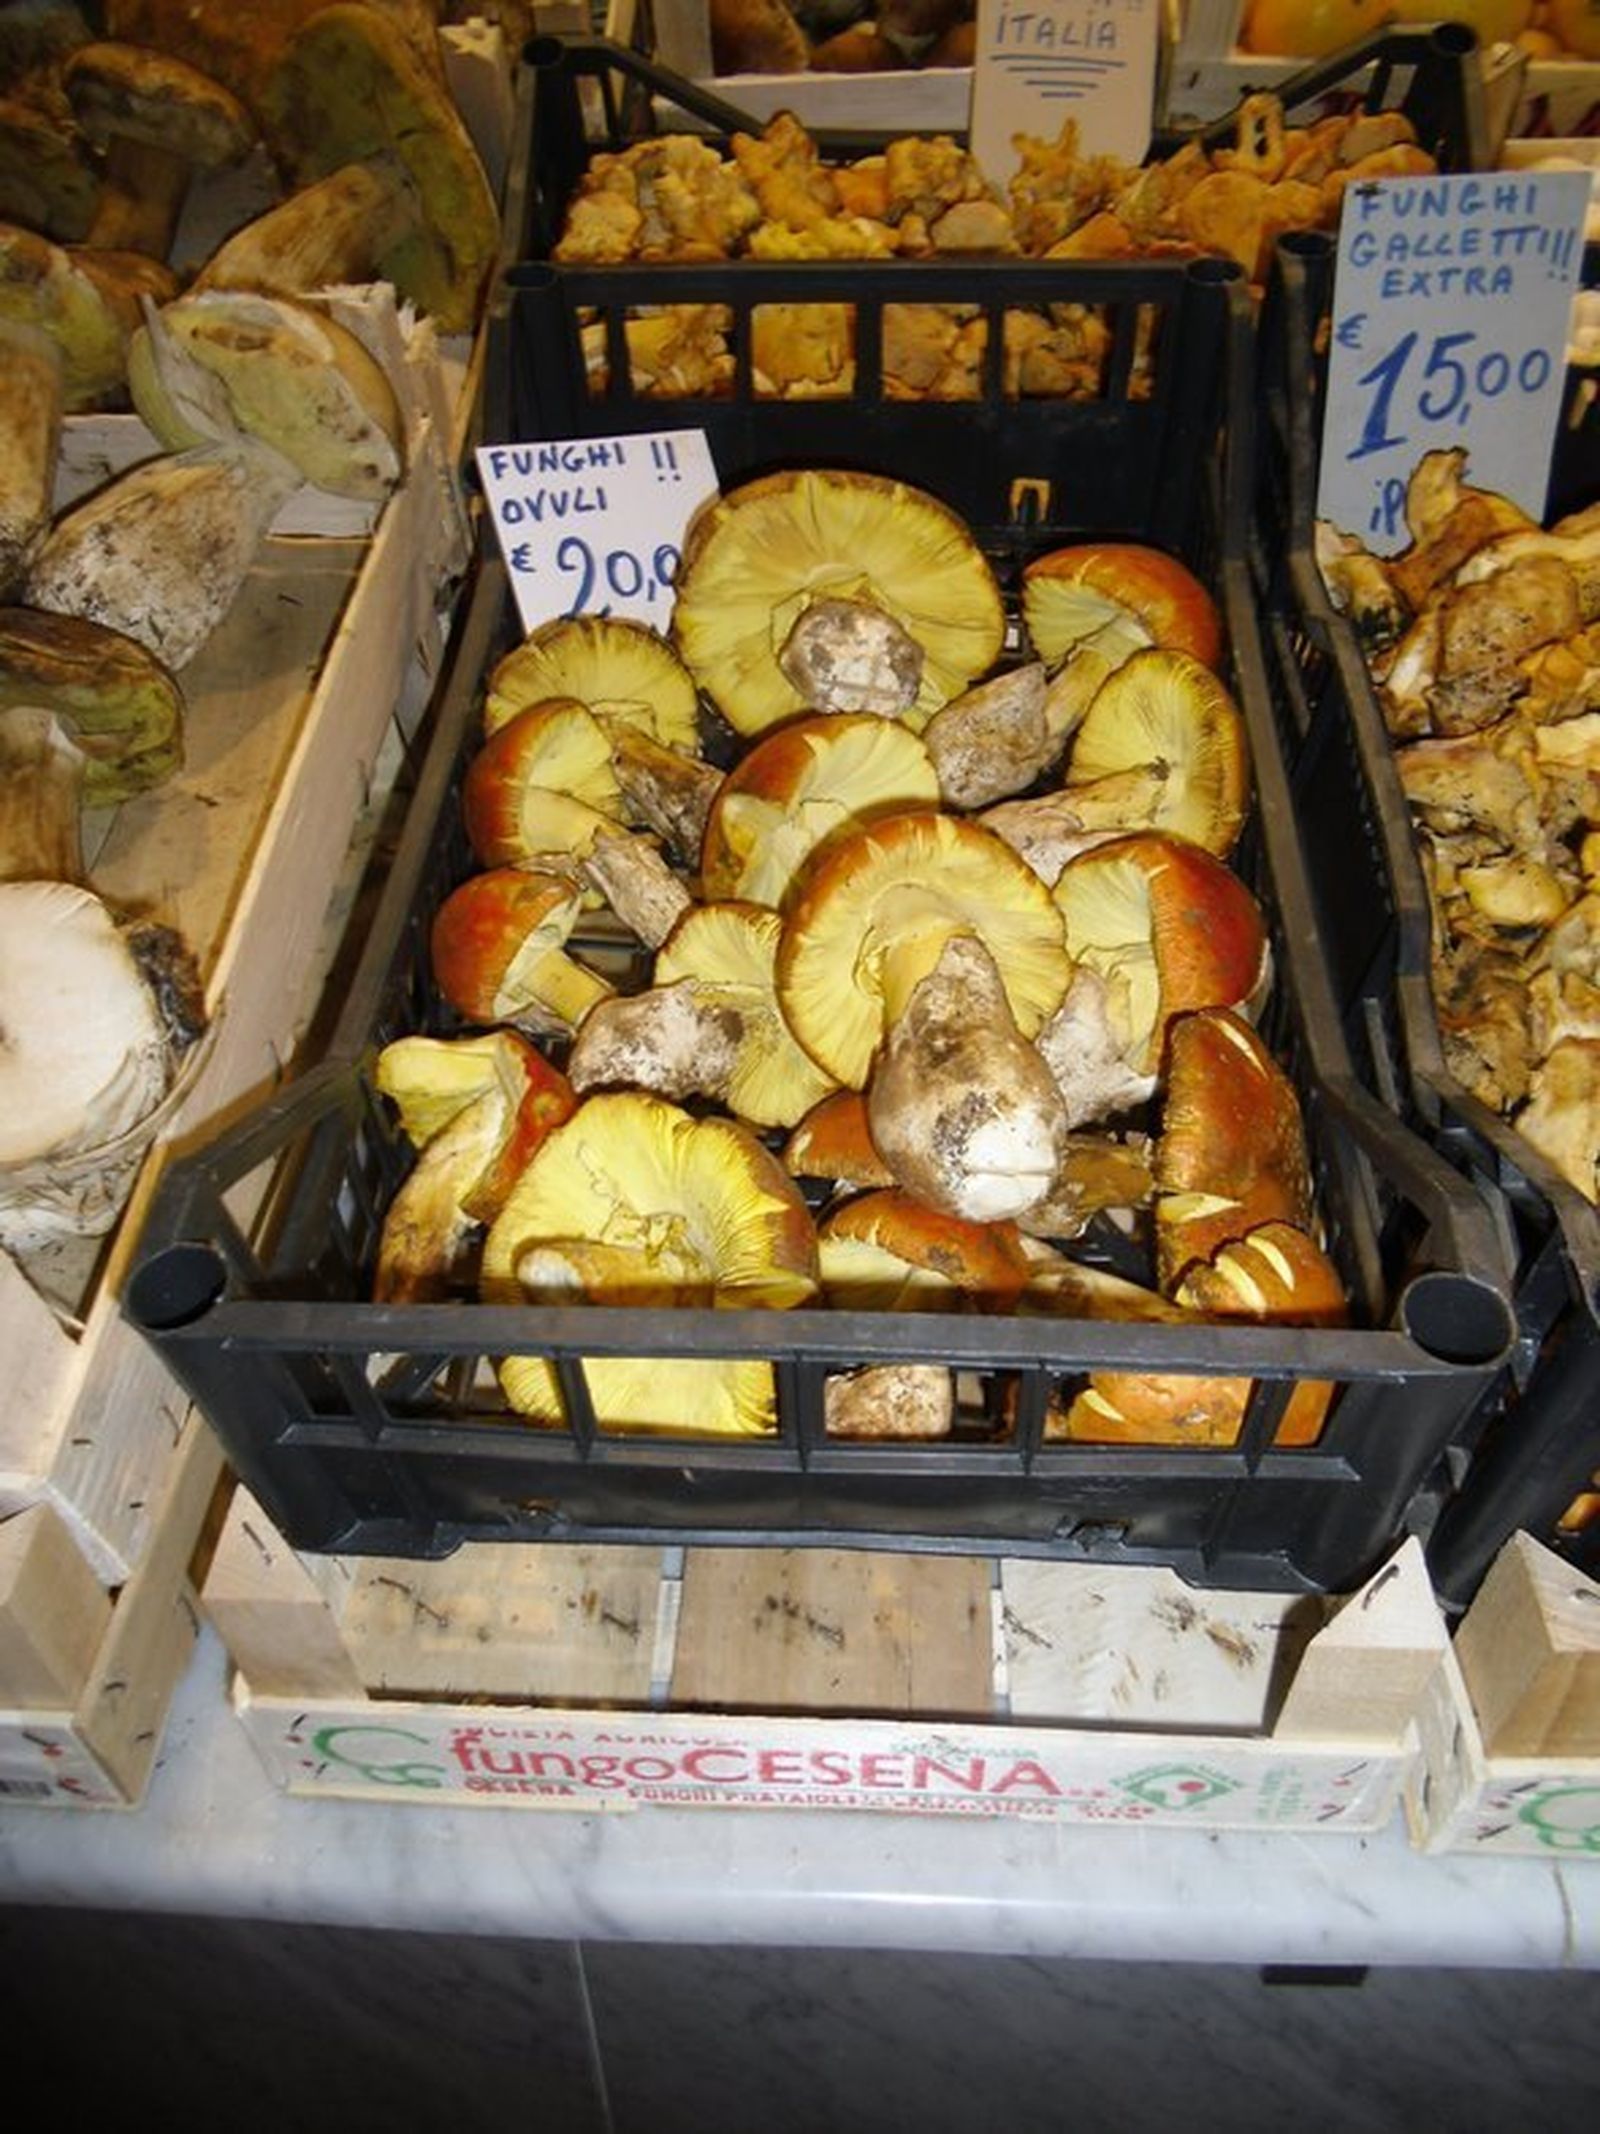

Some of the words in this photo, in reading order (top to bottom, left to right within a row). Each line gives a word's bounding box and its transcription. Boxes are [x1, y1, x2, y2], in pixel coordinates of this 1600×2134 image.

[1356, 182, 1536, 220] FUNGHI
[1381, 265, 1513, 298] EXTRA
[489, 441, 626, 480] FUNGHI
